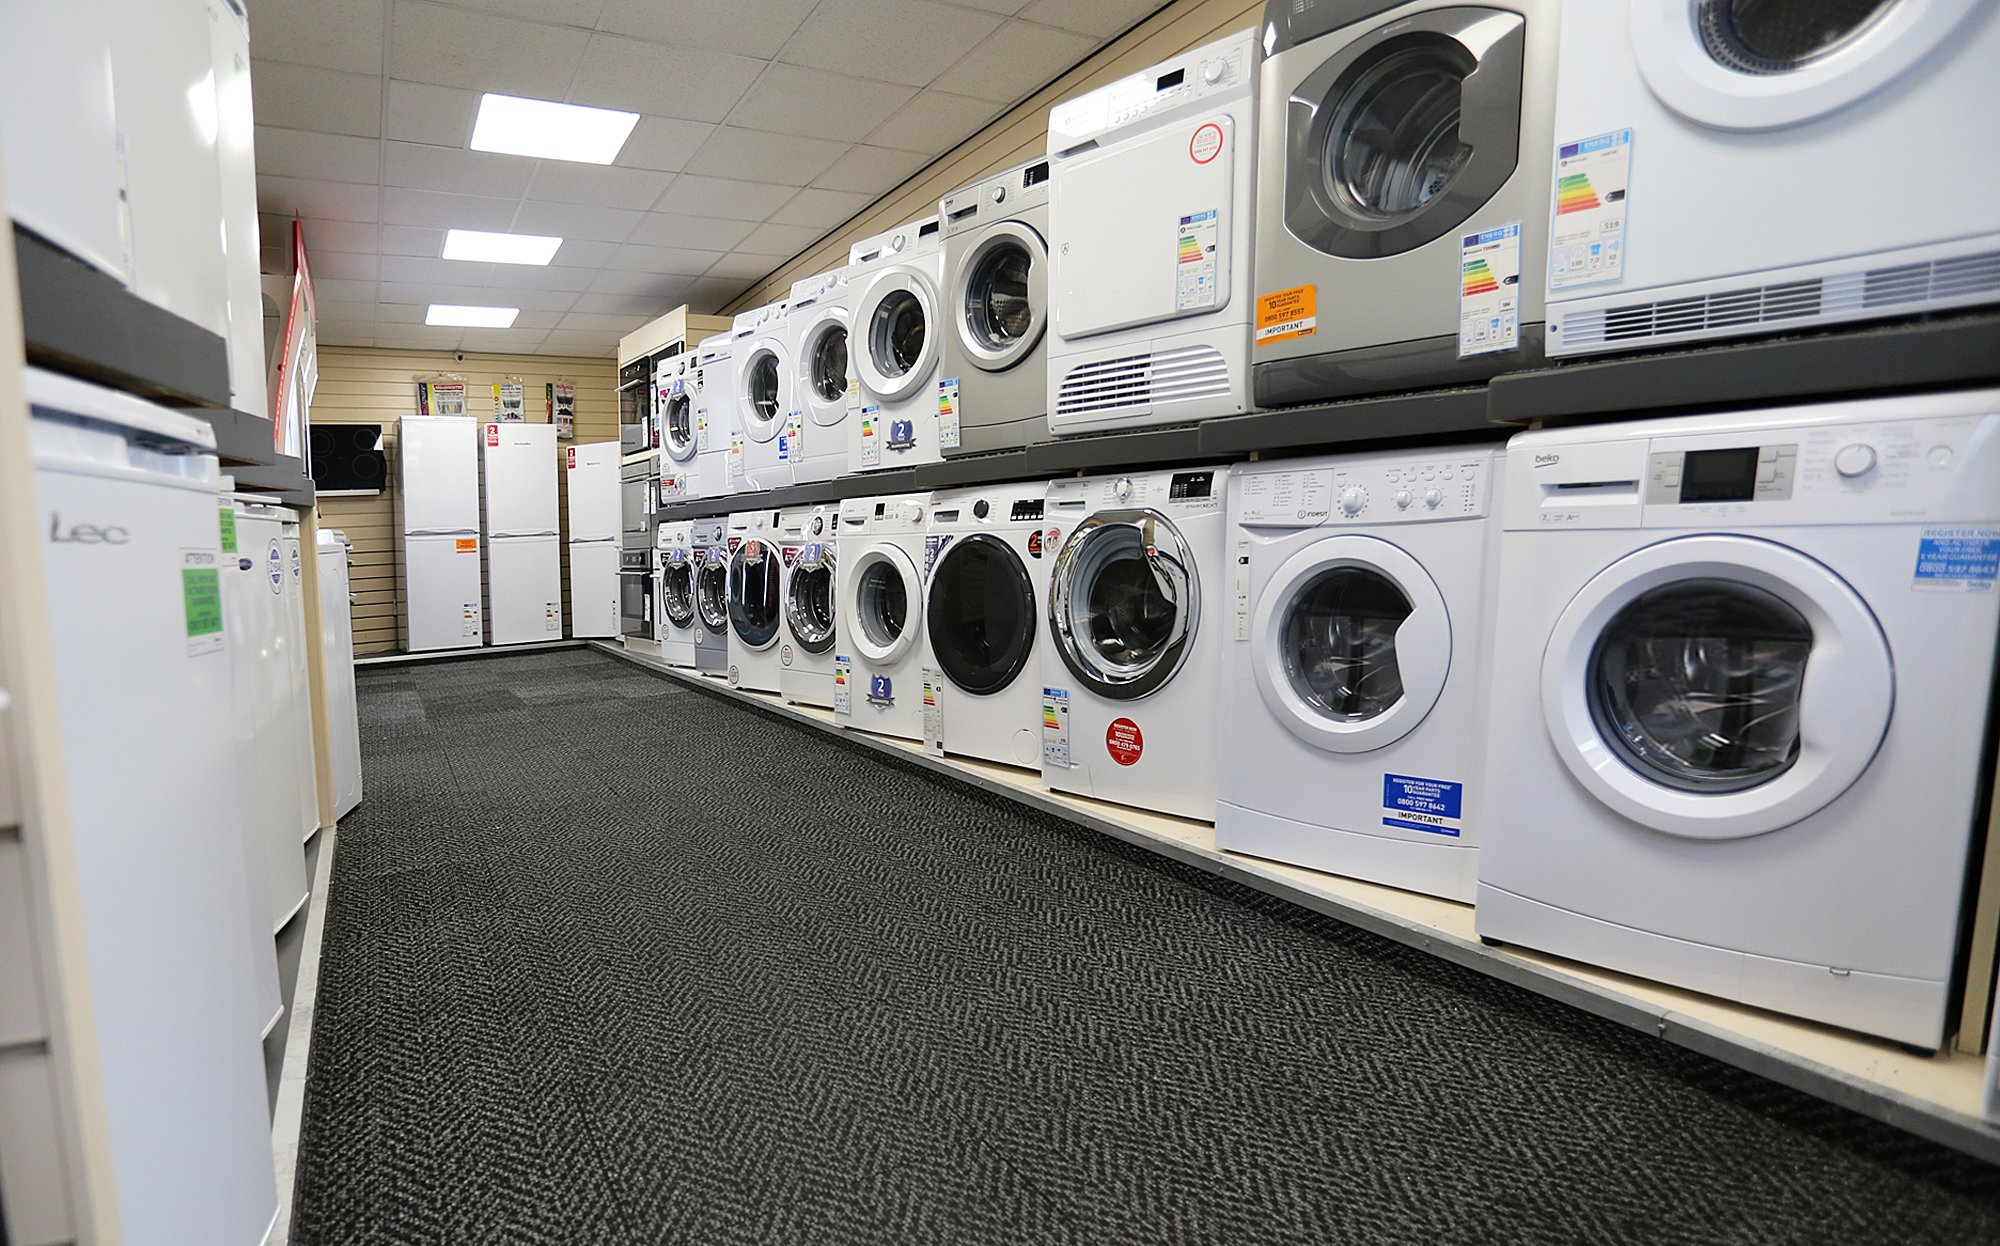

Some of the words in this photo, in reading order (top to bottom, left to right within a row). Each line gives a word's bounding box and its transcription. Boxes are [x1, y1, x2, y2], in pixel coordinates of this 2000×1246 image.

[1269, 300, 1277, 309] 10
[1264, 321, 1304, 336] IMPORTANT
[897, 423, 905, 437] 2
[50, 511, 130, 545] Lec
[1923, 529, 1974, 538] REGISTER
[1030, 533, 1039, 547] 2
[877, 679, 885, 692] 2
[1403, 784, 1413, 794] 10
[1396, 797, 1414, 806] 0800
[1415, 800, 1428, 809] 597
[1428, 802, 1446, 812] 8642
[1398, 811, 1444, 825] IMPORTANT
